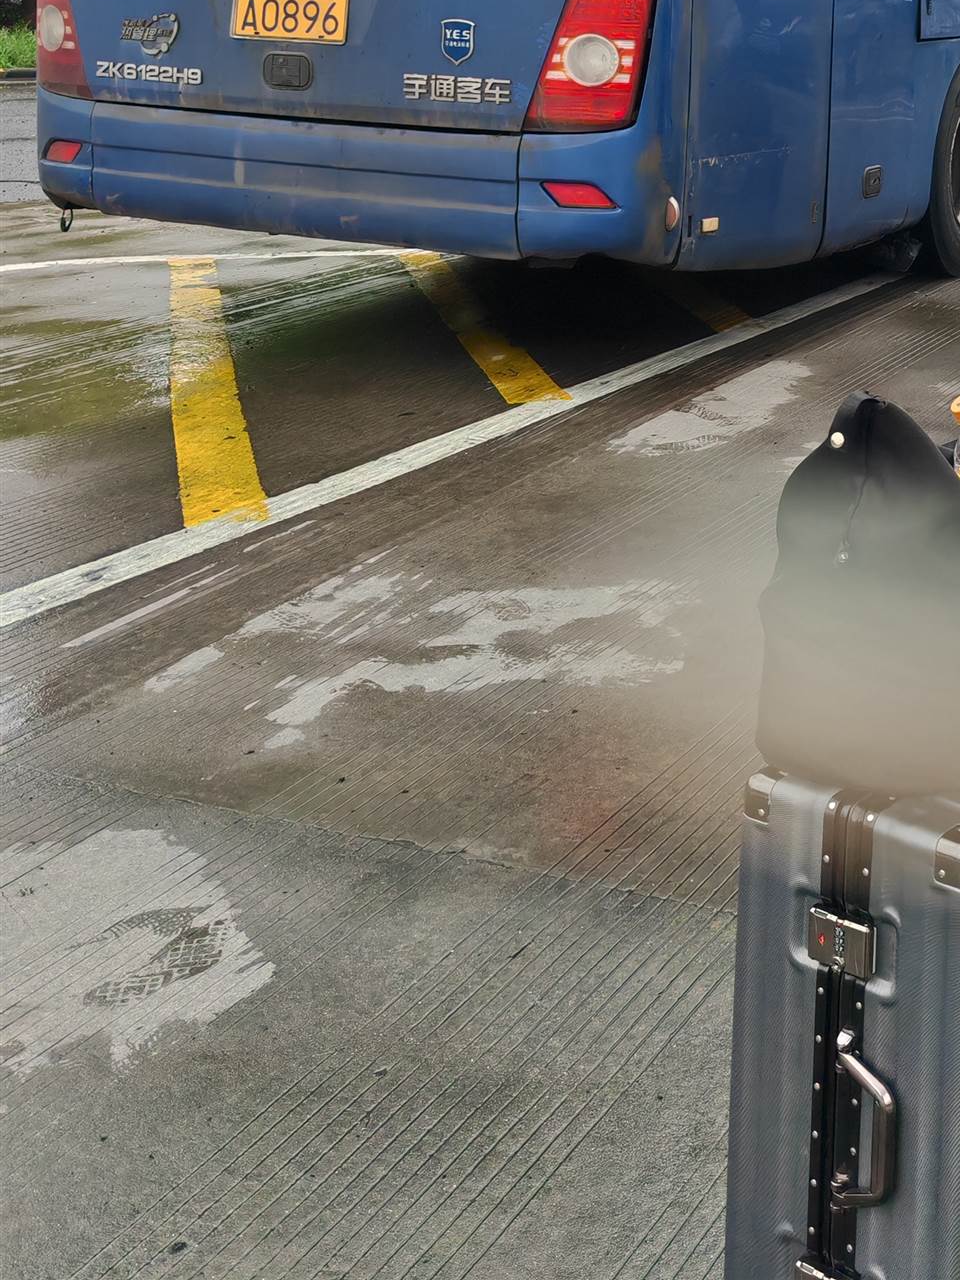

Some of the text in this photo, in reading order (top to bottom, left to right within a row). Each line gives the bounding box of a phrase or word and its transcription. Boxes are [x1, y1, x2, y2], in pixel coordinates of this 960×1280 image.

[445, 29, 470, 40] YES
[95, 60, 204, 85] ZK6122H9
[403, 73, 511, 105] 宇通客车
